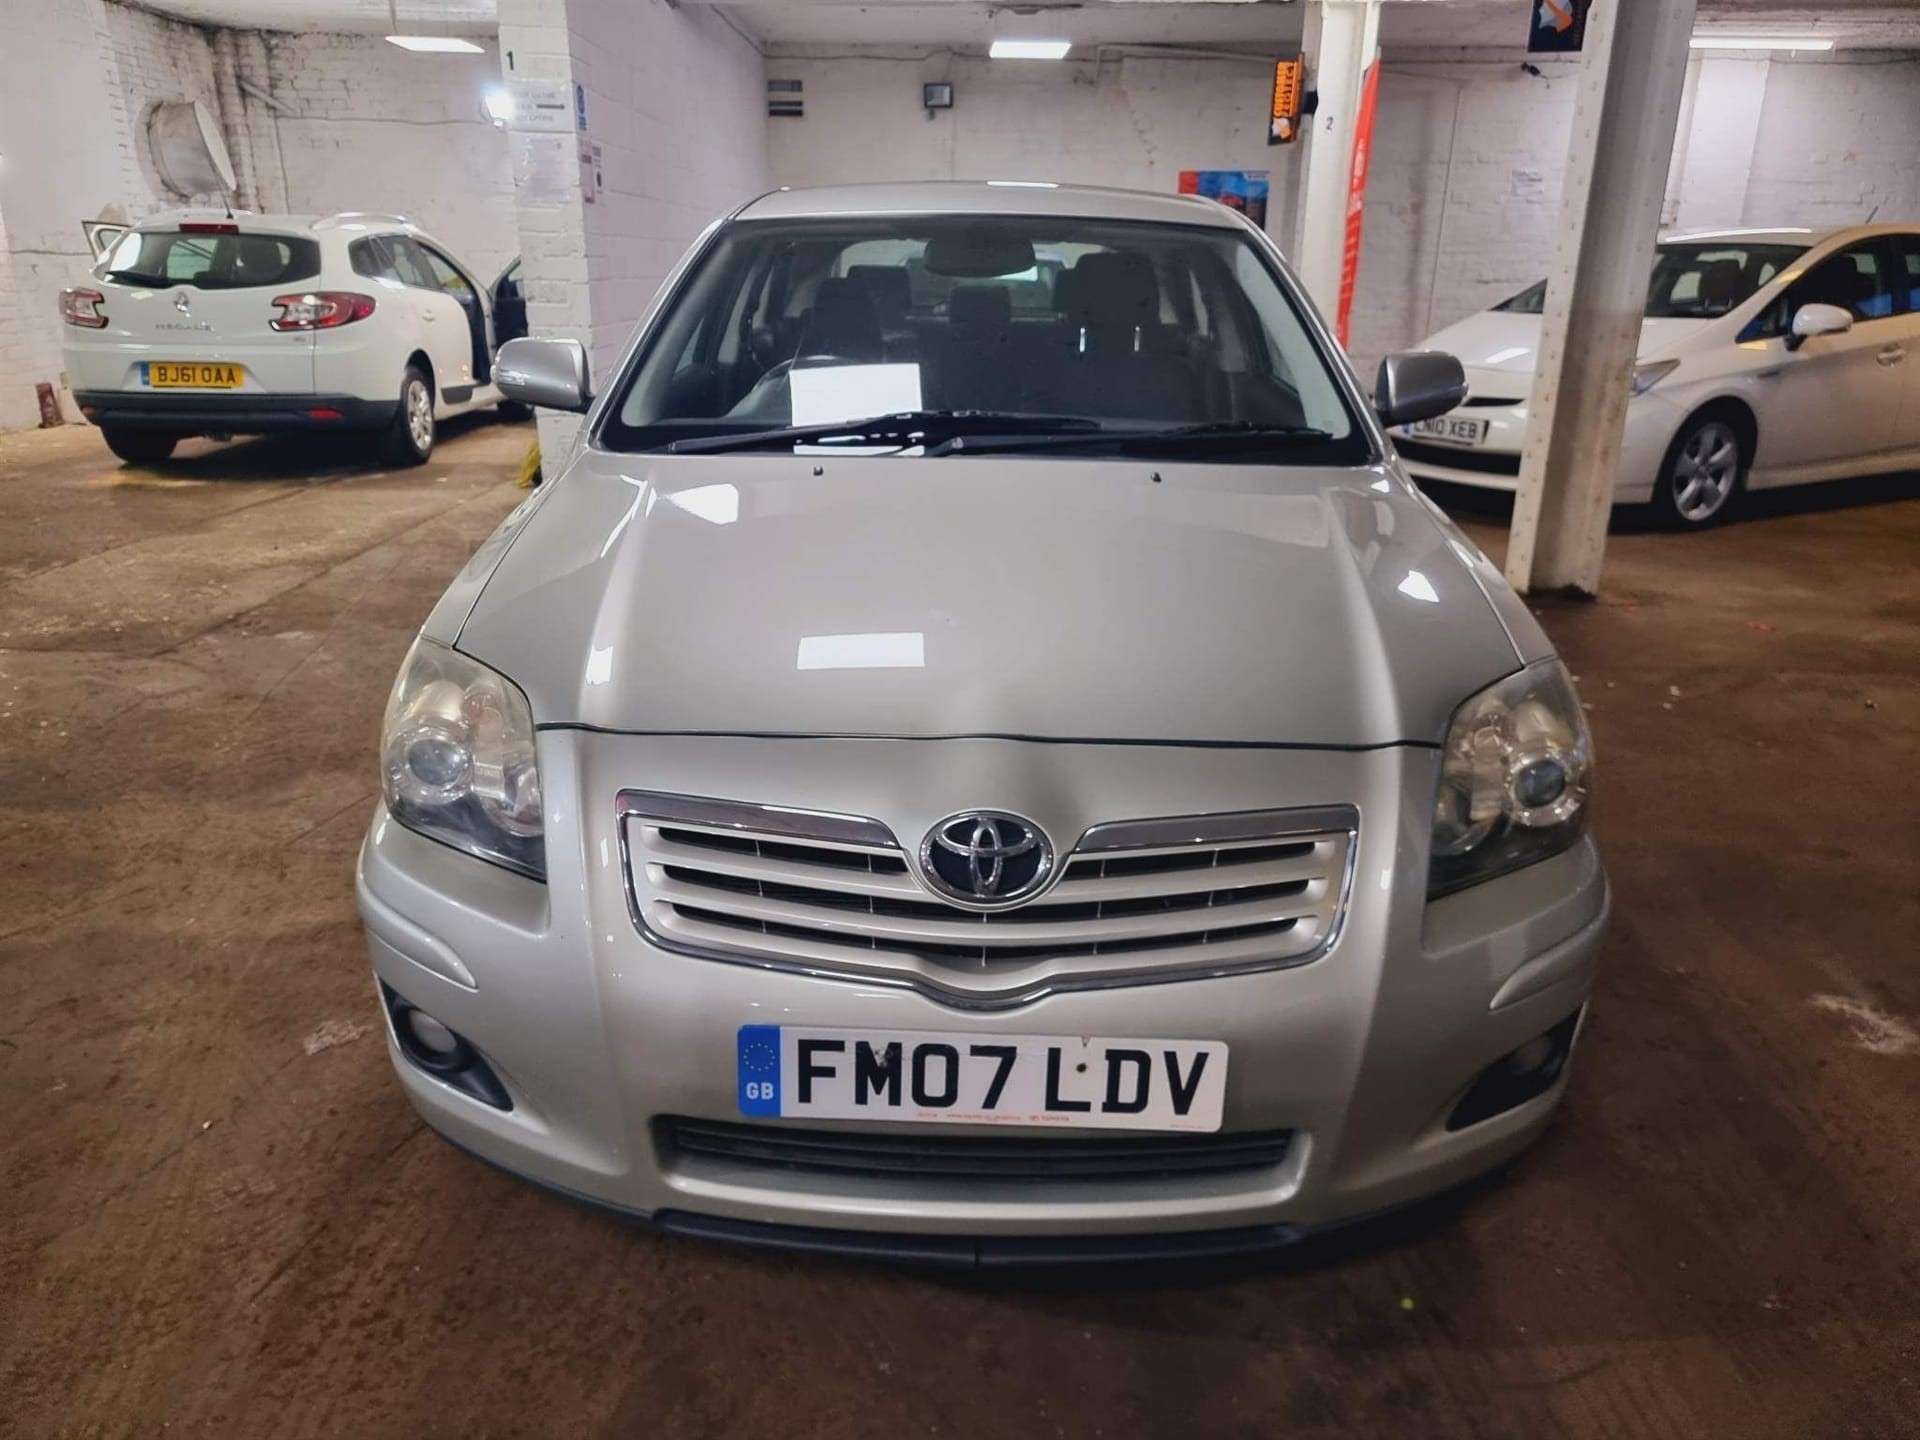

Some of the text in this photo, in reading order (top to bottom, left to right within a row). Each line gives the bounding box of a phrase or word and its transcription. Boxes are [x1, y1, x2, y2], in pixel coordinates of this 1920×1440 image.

[506, 50, 514, 71] 1
[1325, 116, 1334, 131] 2
[157, 366, 236, 384] BJ61 OAA
[1449, 420, 1477, 439] XEB
[797, 1038, 1210, 1116] FM07 LDV
[745, 1081, 774, 1100] GB
